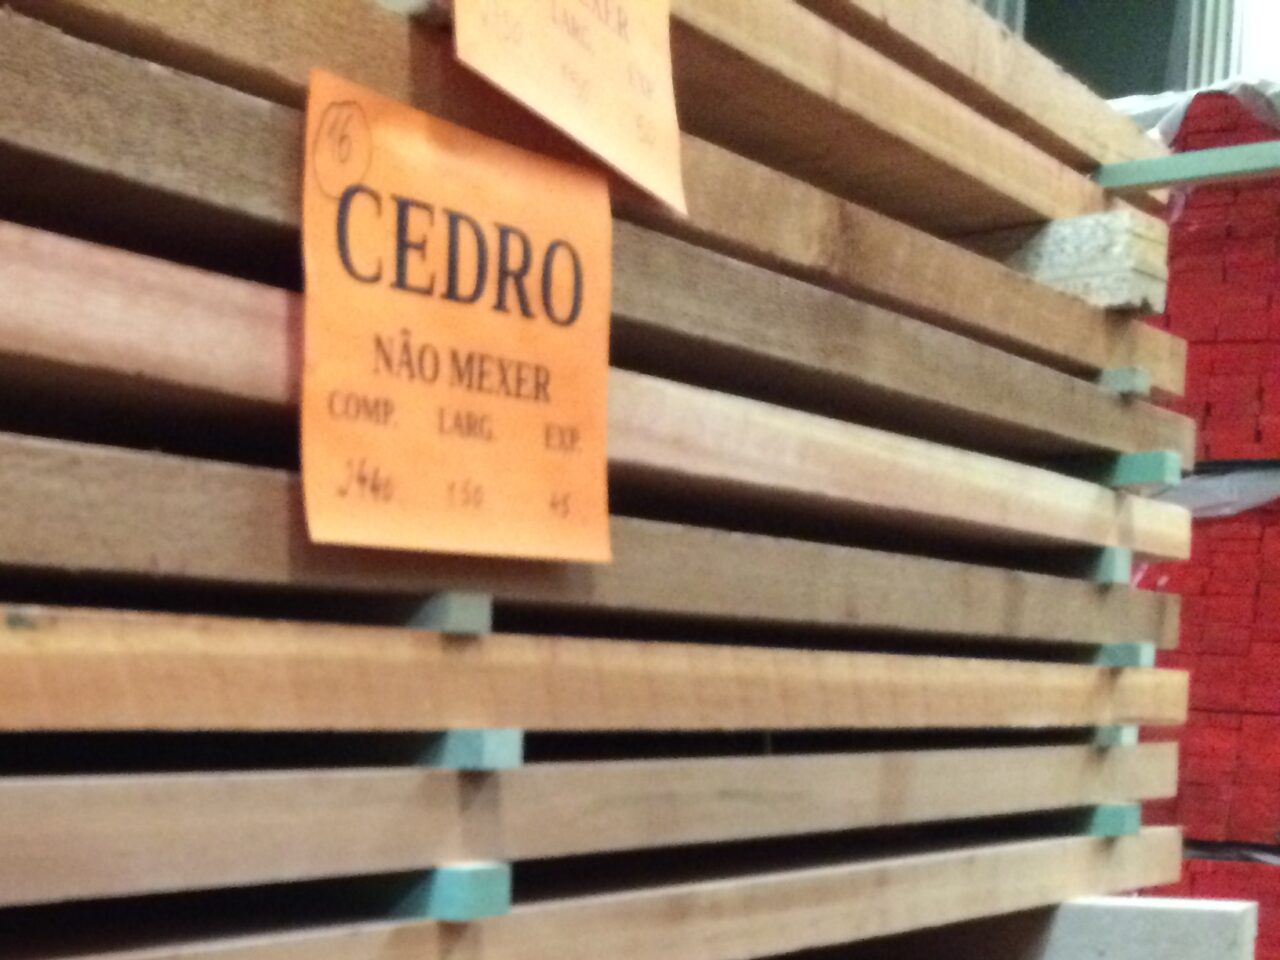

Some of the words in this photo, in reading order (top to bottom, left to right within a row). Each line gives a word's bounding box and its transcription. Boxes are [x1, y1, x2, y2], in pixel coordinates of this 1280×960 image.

[336, 183, 584, 327] CEDRO
[373, 327, 441, 384] NÃO
[449, 349, 551, 402] MEXER
